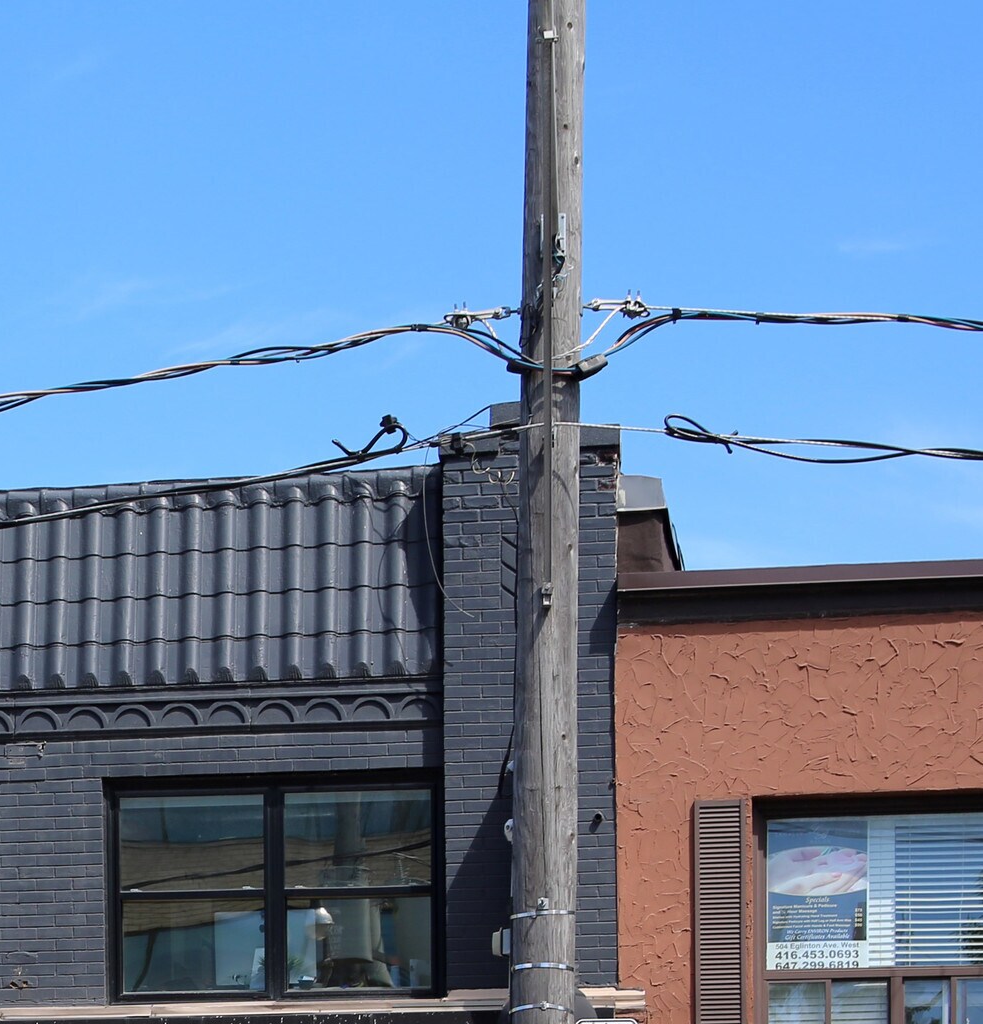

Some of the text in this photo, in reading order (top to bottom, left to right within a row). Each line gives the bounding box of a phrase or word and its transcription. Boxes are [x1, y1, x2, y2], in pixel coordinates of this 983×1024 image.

[805, 896, 830, 904] Specials
[790, 942, 820, 950] Eglinton
[775, 950, 859, 960] 416.453.0693
[775, 960, 859, 969] 647.299.6819
